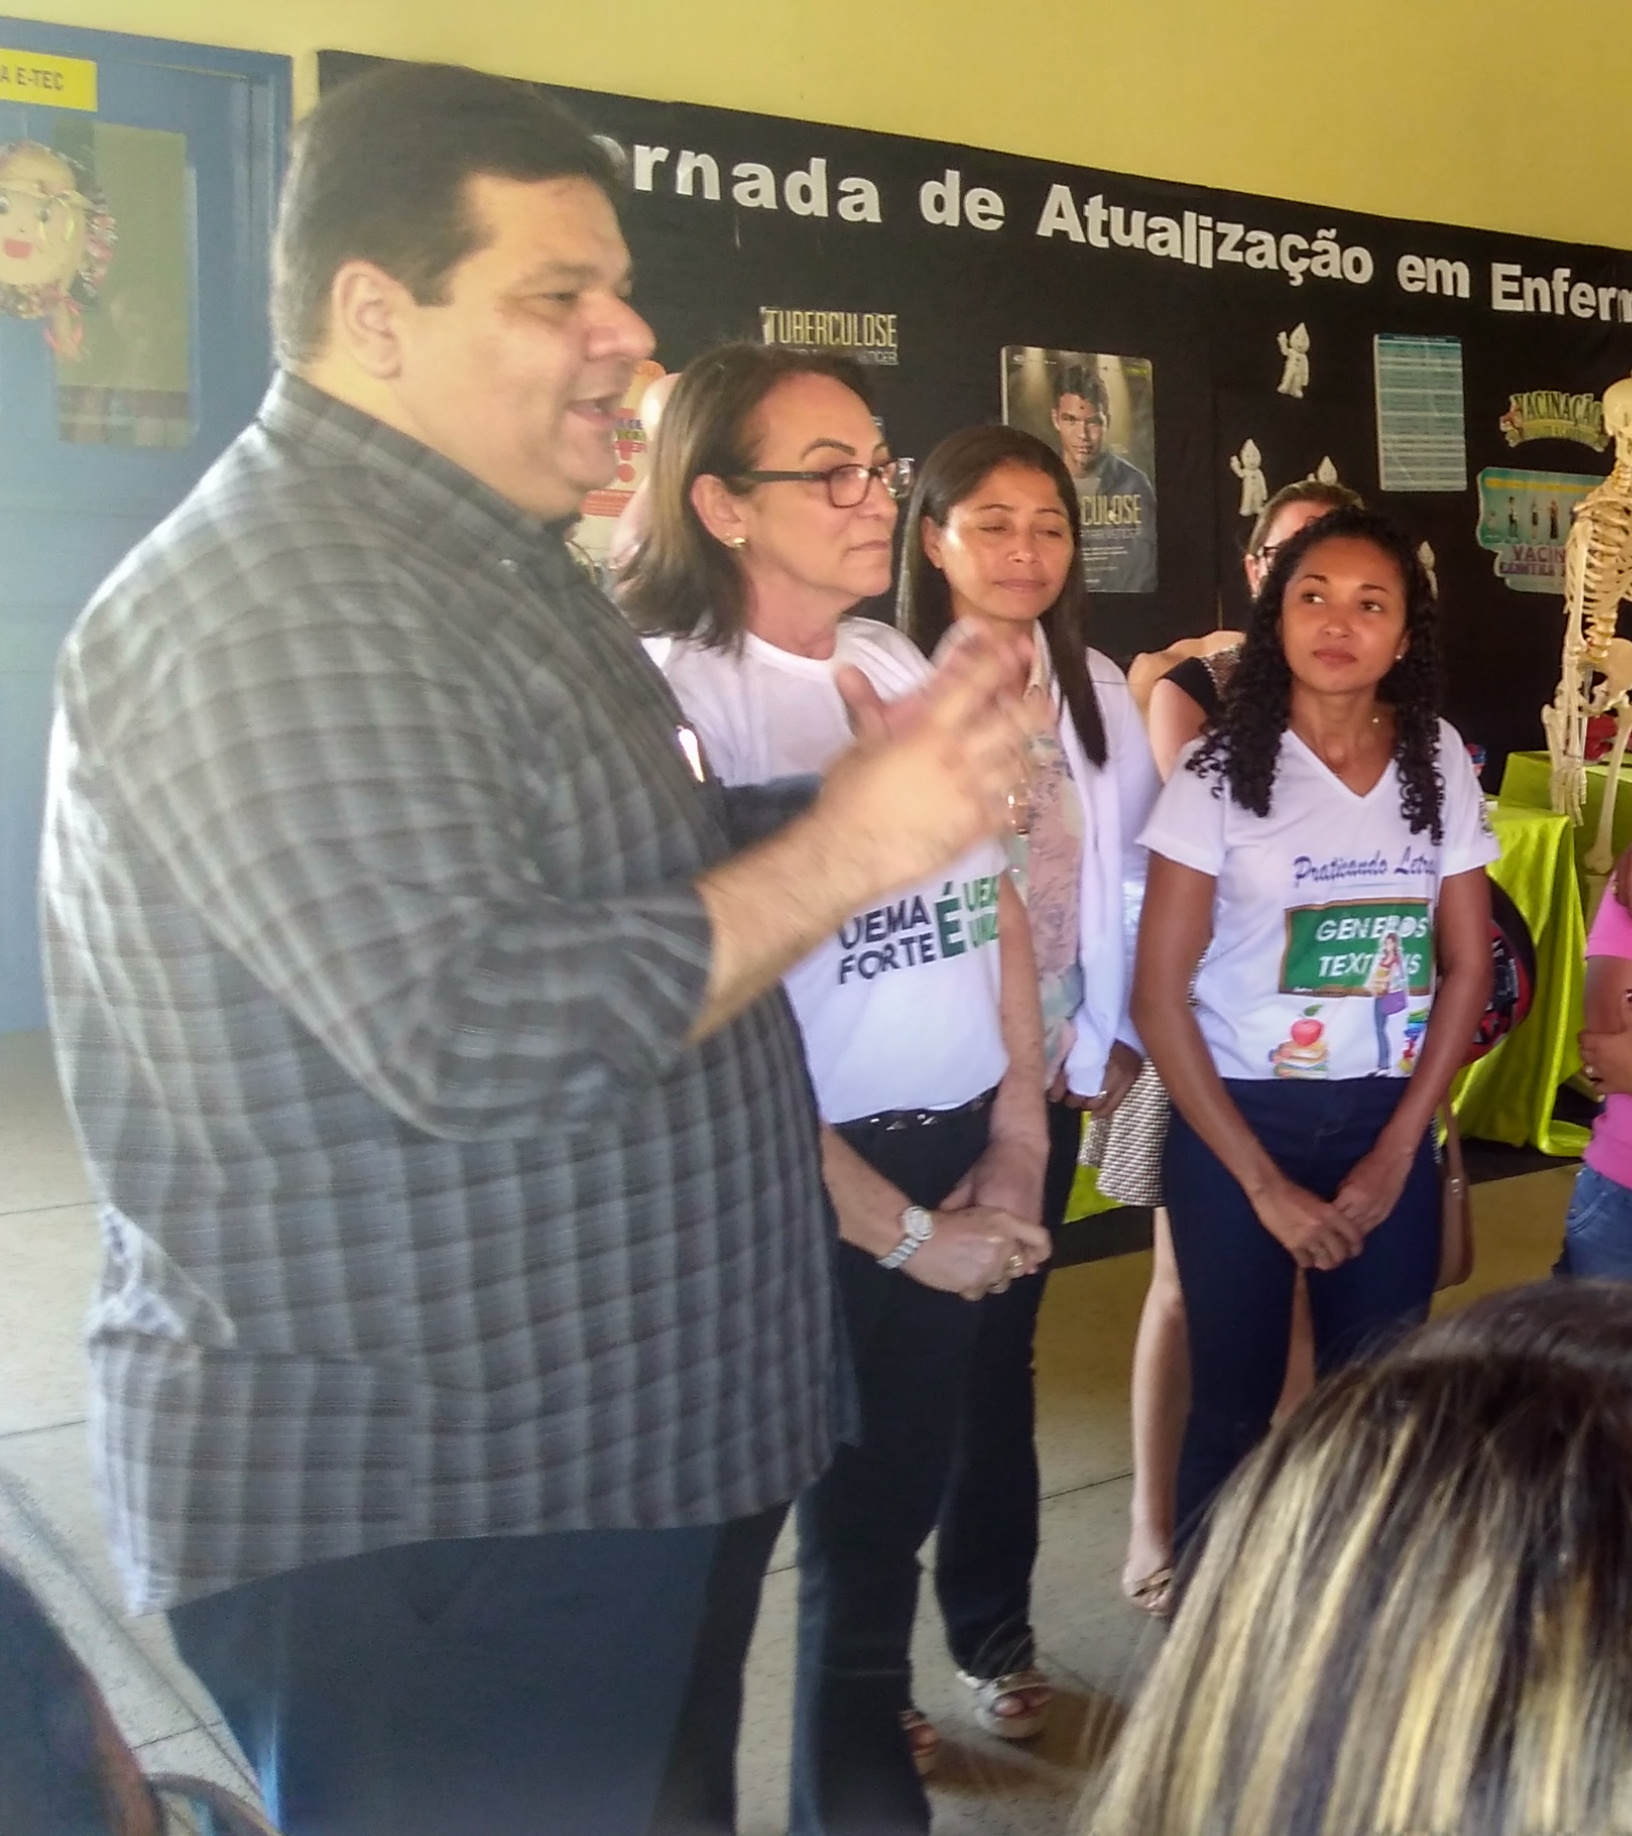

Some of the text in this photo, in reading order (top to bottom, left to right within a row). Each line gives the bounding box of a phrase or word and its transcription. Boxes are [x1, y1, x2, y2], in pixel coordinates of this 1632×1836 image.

[16, 66, 64, 91] E-TEC
[920, 169, 1005, 231] de
[1036, 184, 1374, 287] Atualização
[1397, 253, 1470, 299] em
[763, 310, 897, 347] TUBERCULOSE
[935, 881, 967, 958] É
[838, 932, 937, 984] FORTE
